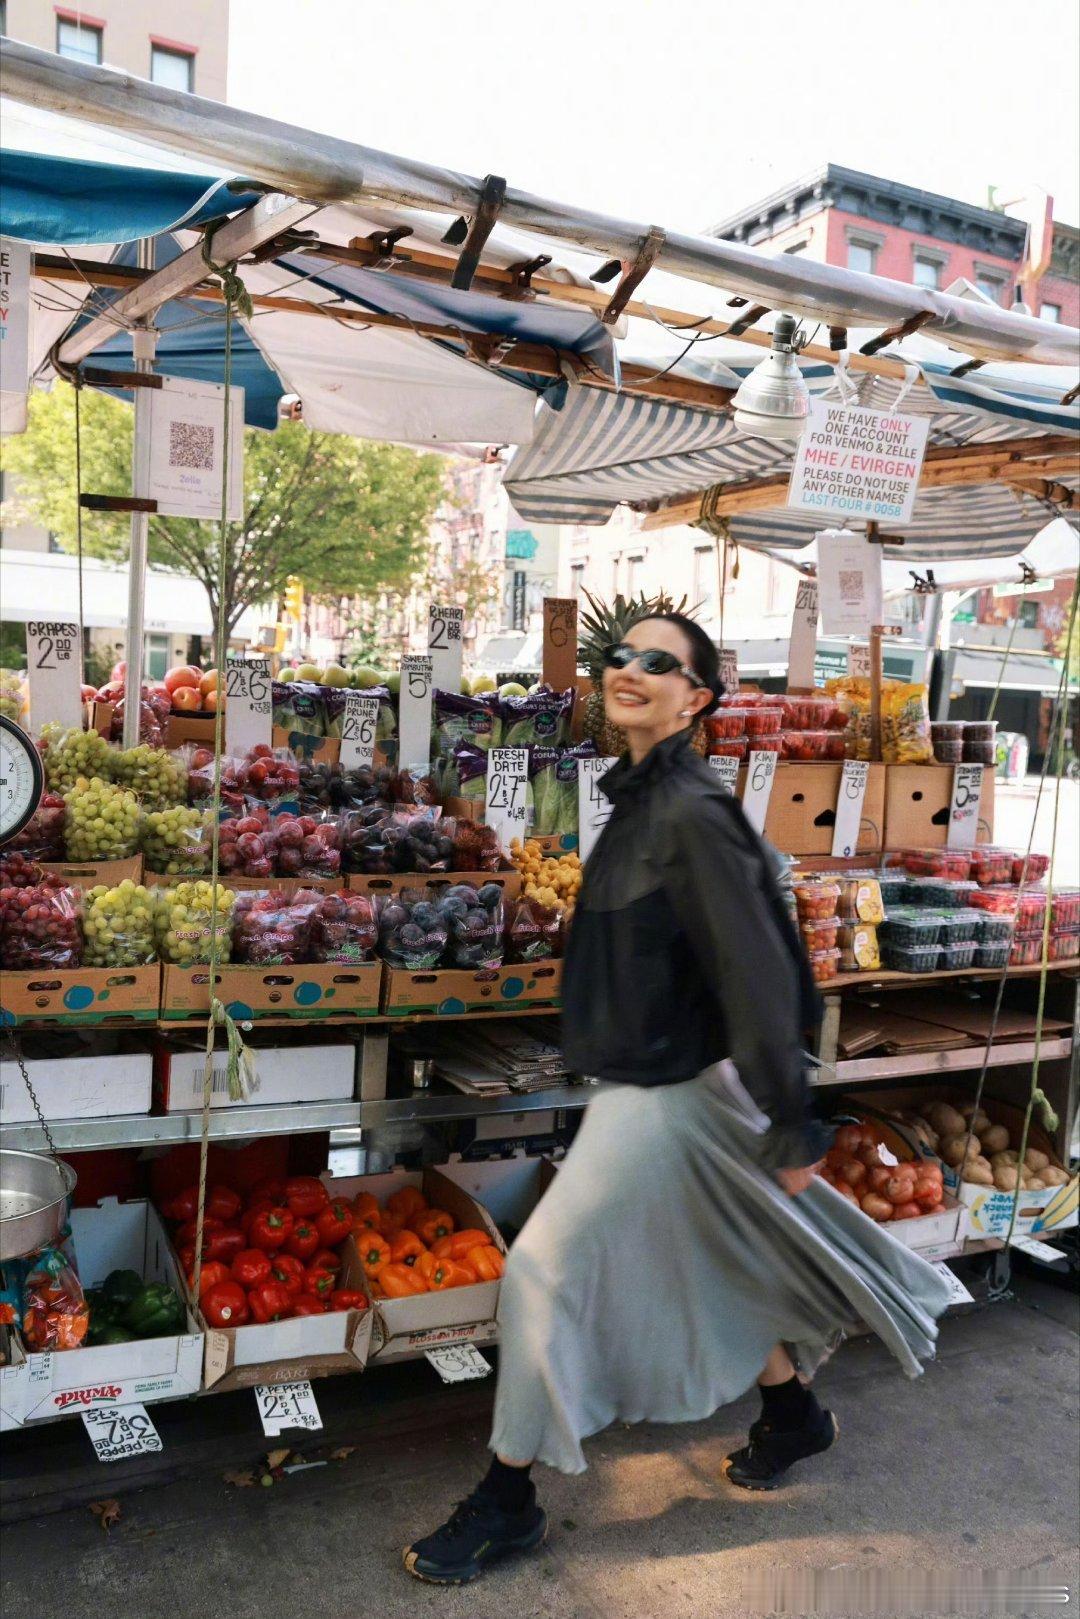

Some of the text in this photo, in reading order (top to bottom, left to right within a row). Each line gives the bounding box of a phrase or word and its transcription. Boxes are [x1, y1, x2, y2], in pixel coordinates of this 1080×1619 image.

[828, 409, 912, 432] WE HAVE ONLY
[810, 432, 918, 459] FOR VENMO & ZELLE
[825, 422, 908, 445] ONE ACCOUNT
[805, 448, 916, 478] MHE / EVIRGEN
[803, 467, 910, 493] PLEASE DO NOT USE
[803, 480, 905, 504] ANY OTHER NAMES
[802, 492, 902, 516] LAST FOUR # 0058
[28, 621, 77, 637] GRAPES
[430, 618, 449, 649] 2
[550, 614, 567, 647] 6
[37, 637, 56, 669] 2
[227, 670, 241, 697] 2
[250, 670, 267, 700] 6
[408, 672, 427, 699] 5
[347, 698, 378, 710] ITALIAN
[347, 708, 374, 718] PRUNE
[343, 718, 355, 740] 2
[361, 719, 372, 743] 6
[492, 750, 525, 760] FRESH
[495, 762, 524, 772] DATE
[583, 759, 609, 773] FIGS
[9, 763, 14, 772] 2
[752, 764, 765, 791] 6
[8, 790, 13, 799] 3
[489, 774, 506, 808] 2
[509, 776, 519, 808] 7
[590, 775, 604, 809] 4
[846, 776, 859, 799] 3
[956, 776, 969, 808] 5
[175, 930, 200, 939] Fresh
[54, 1385, 122, 1406] PRIMA
[264, 1395, 285, 1418] 2
[290, 1394, 301, 1414] 1
[97, 1420, 124, 1445] 2
[128, 1415, 157, 1439] 3
